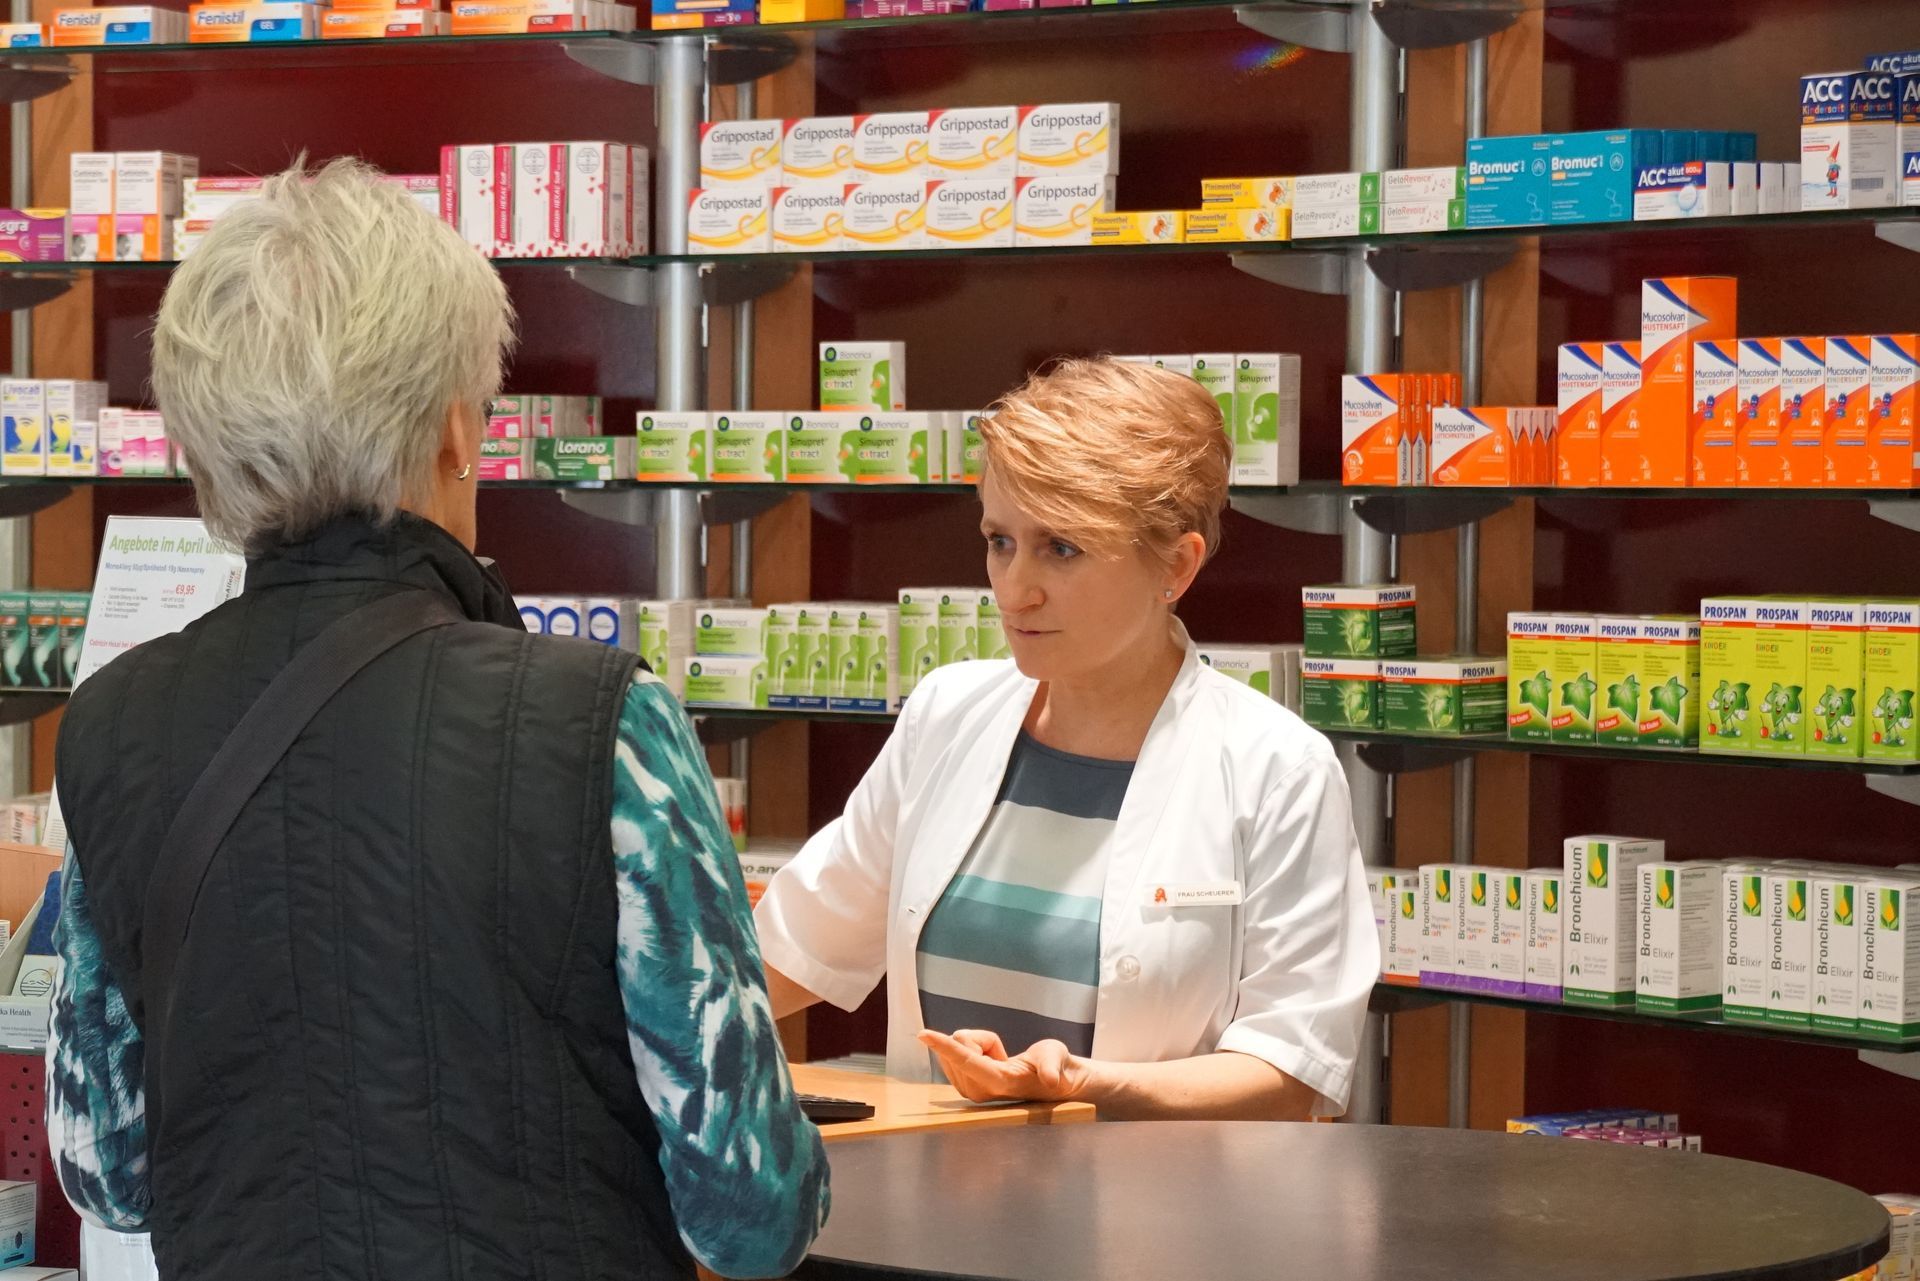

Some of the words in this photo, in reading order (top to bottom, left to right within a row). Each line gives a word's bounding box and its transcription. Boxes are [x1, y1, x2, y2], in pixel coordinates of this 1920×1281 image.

[58, 14, 101, 26] Fenistil
[197, 11, 245, 25] Fenistil
[1870, 57, 1900, 73] ACC
[1803, 79, 1843, 103] ACC
[1851, 78, 1891, 101] ACC
[940, 116, 1009, 133] Grippostad
[1031, 112, 1101, 130] Grippostad
[865, 122, 929, 137] Grippostad
[711, 129, 774, 144] Grippostad
[1469, 160, 1519, 175] Bromuc
[1551, 155, 1599, 170] Bromuc
[1388, 173, 1433, 184] GeloRevoice
[1638, 168, 1666, 187] ACC
[1667, 166, 1685, 176] akut
[938, 187, 1007, 205] Grippostad
[1028, 183, 1097, 202] Grippostad
[700, 195, 762, 212] Grippostad
[854, 191, 920, 208] Grippostad
[1294, 211, 1338, 221] GeloRevoice
[1387, 205, 1428, 216] GeloRevoice
[1643, 312, 1685, 322] Mucosolvan
[1642, 323, 1685, 331] HUSTENSAFT
[824, 368, 858, 377] Sinupret
[1561, 371, 1599, 381] Mucosolvan
[1603, 371, 1640, 380] Mucosolvan
[1694, 368, 1734, 379] Mucosolvan
[1739, 368, 1778, 378] Mucosolvan
[1782, 367, 1822, 378] Mucosolvan
[1826, 367, 1867, 377] Mucosolvan
[1871, 366, 1912, 376] Mucosolvan
[824, 380, 853, 388] extract
[1240, 375, 1271, 384] Sinupret
[1344, 400, 1382, 410] Mucosolvan
[1434, 422, 1475, 432] Mucosolvan
[558, 440, 607, 454] Lorano
[641, 437, 675, 446] Sinupret
[717, 437, 751, 447] Sinupret
[790, 437, 824, 447] Sinupret
[859, 438, 895, 447] Sinupret
[717, 450, 745, 458] extract
[790, 450, 820, 458] extract
[859, 450, 889, 458] extract
[109, 535, 159, 554] Angebote
[160, 536, 174, 552] im
[177, 537, 204, 557] April
[175, 584, 195, 596] €9,95
[1305, 592, 1335, 602] PROSPAN
[1378, 591, 1411, 602] PROSPAN
[1704, 606, 1746, 619] PROSPAN
[1756, 608, 1798, 621] PROSPAN
[1811, 609, 1853, 623] PROSPAN
[1870, 610, 1911, 623] PROSPAN
[1513, 622, 1547, 633] PROSPAN
[1555, 623, 1590, 634] PROSPAN
[1602, 625, 1636, 636] PROSPAN
[1644, 626, 1680, 637] PROSPAN
[1704, 642, 1727, 650] KINDER
[1756, 644, 1779, 653] KINDER
[1810, 645, 1833, 655] KINDER
[1869, 647, 1891, 656] KINDER
[1213, 660, 1249, 669] Bionorica
[1305, 662, 1334, 672] PROSPAN
[1386, 666, 1416, 676] PROSPAN
[1462, 667, 1495, 678] PROSPAN
[1570, 847, 1582, 943] Bronchicum
[1422, 873, 1430, 936] Bronchicum
[1458, 876, 1466, 940] Bronchicum
[1492, 880, 1500, 944] Bronchicum
[1528, 883, 1537, 948] Bronchicum
[1640, 872, 1652, 957] Bronchicum
[1389, 893, 1397, 953] Bronchicum
[1727, 880, 1738, 966] Bronchicum
[1771, 884, 1782, 970] Bronchicum
[1817, 888, 1829, 975] Bronchicum
[1863, 892, 1875, 980] Bronchicum
[1584, 932, 1608, 945] Elixir
[1653, 948, 1675, 959] Elixir
[1740, 957, 1762, 968] Elixir
[1785, 961, 1807, 973] Elixir
[1831, 966, 1853, 978] Elixir
[1877, 971, 1900, 984] Elixir
